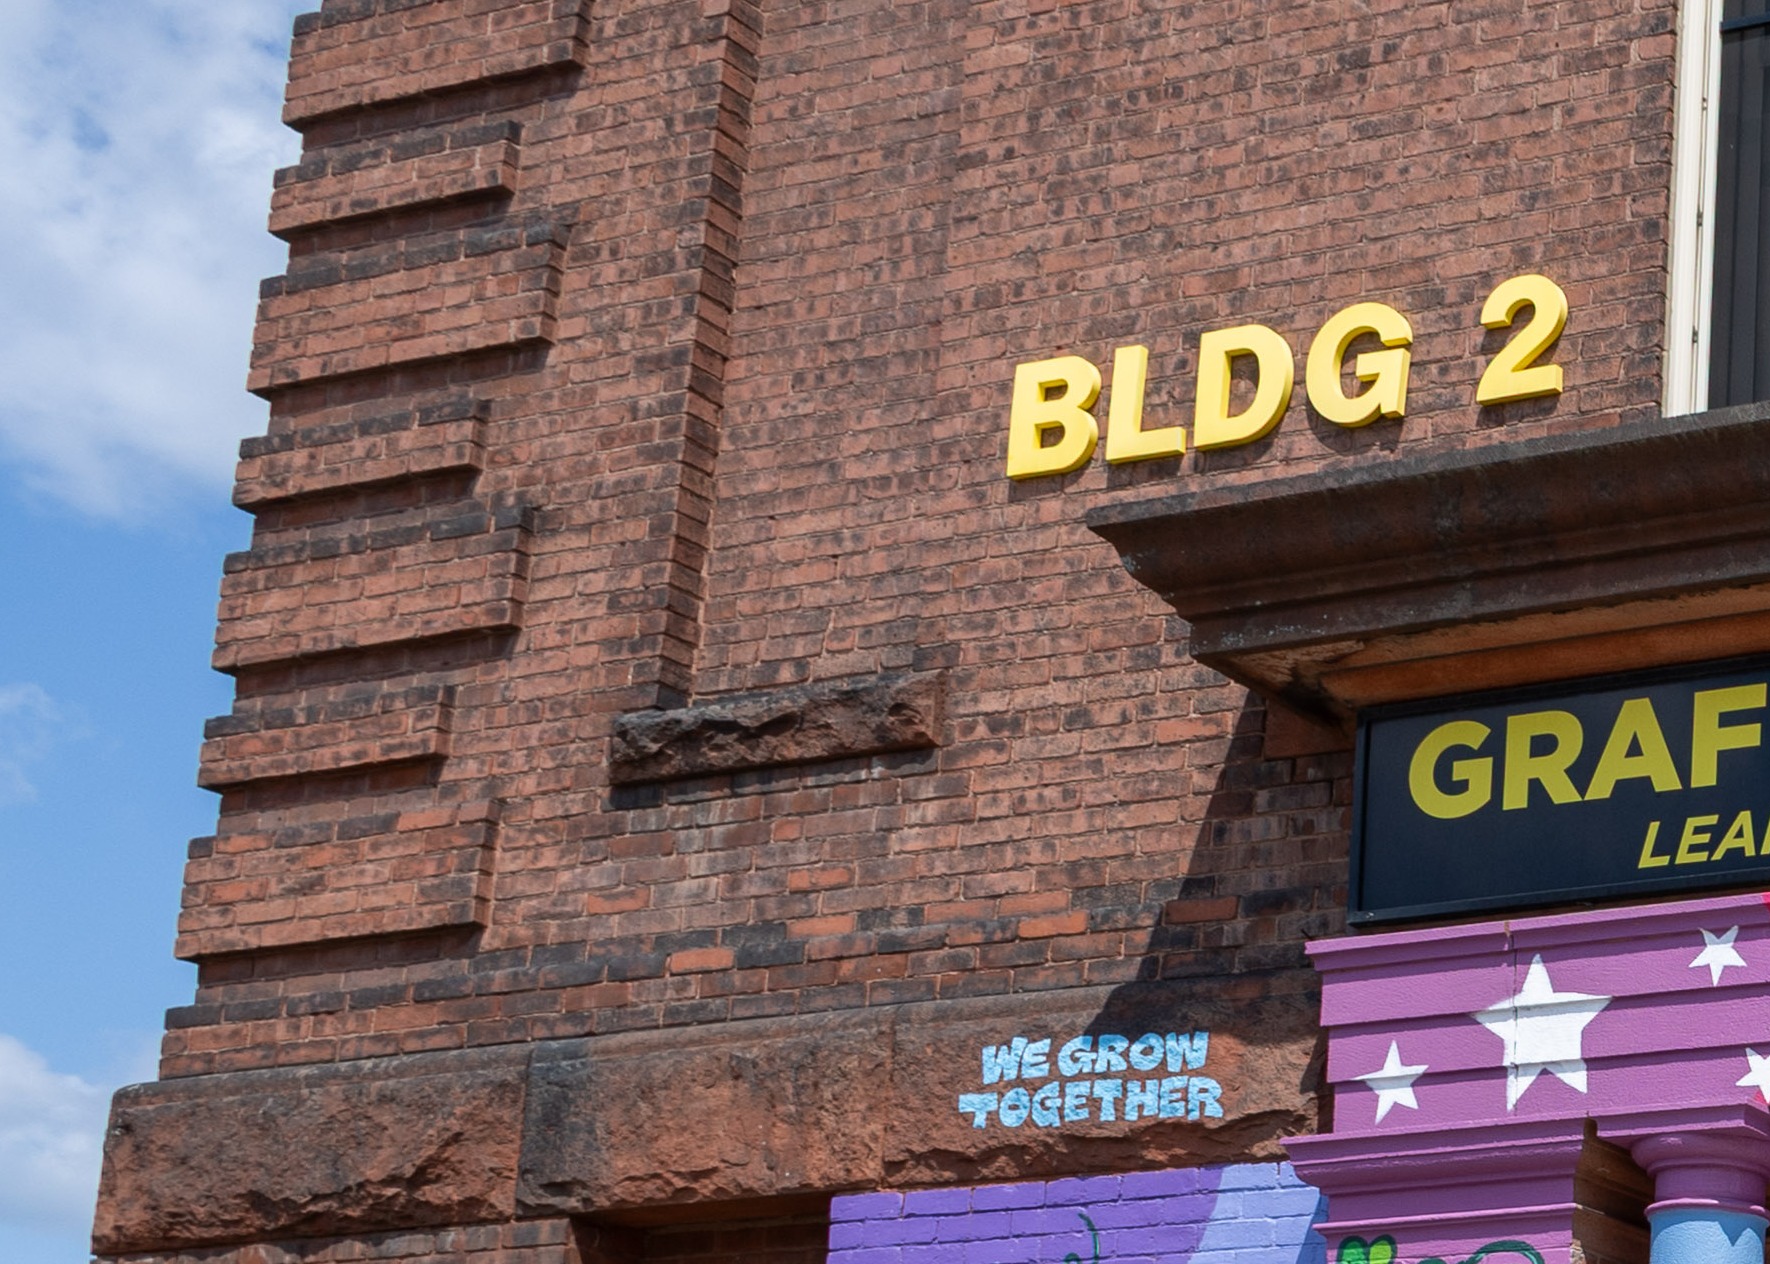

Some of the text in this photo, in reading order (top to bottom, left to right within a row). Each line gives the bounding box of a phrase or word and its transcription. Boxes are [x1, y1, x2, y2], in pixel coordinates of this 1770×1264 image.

[1006, 274, 1569, 480] BLDG 2
[981, 1031, 1210, 1086] WE GROW
[958, 1075, 1224, 1130] TOGETHER
